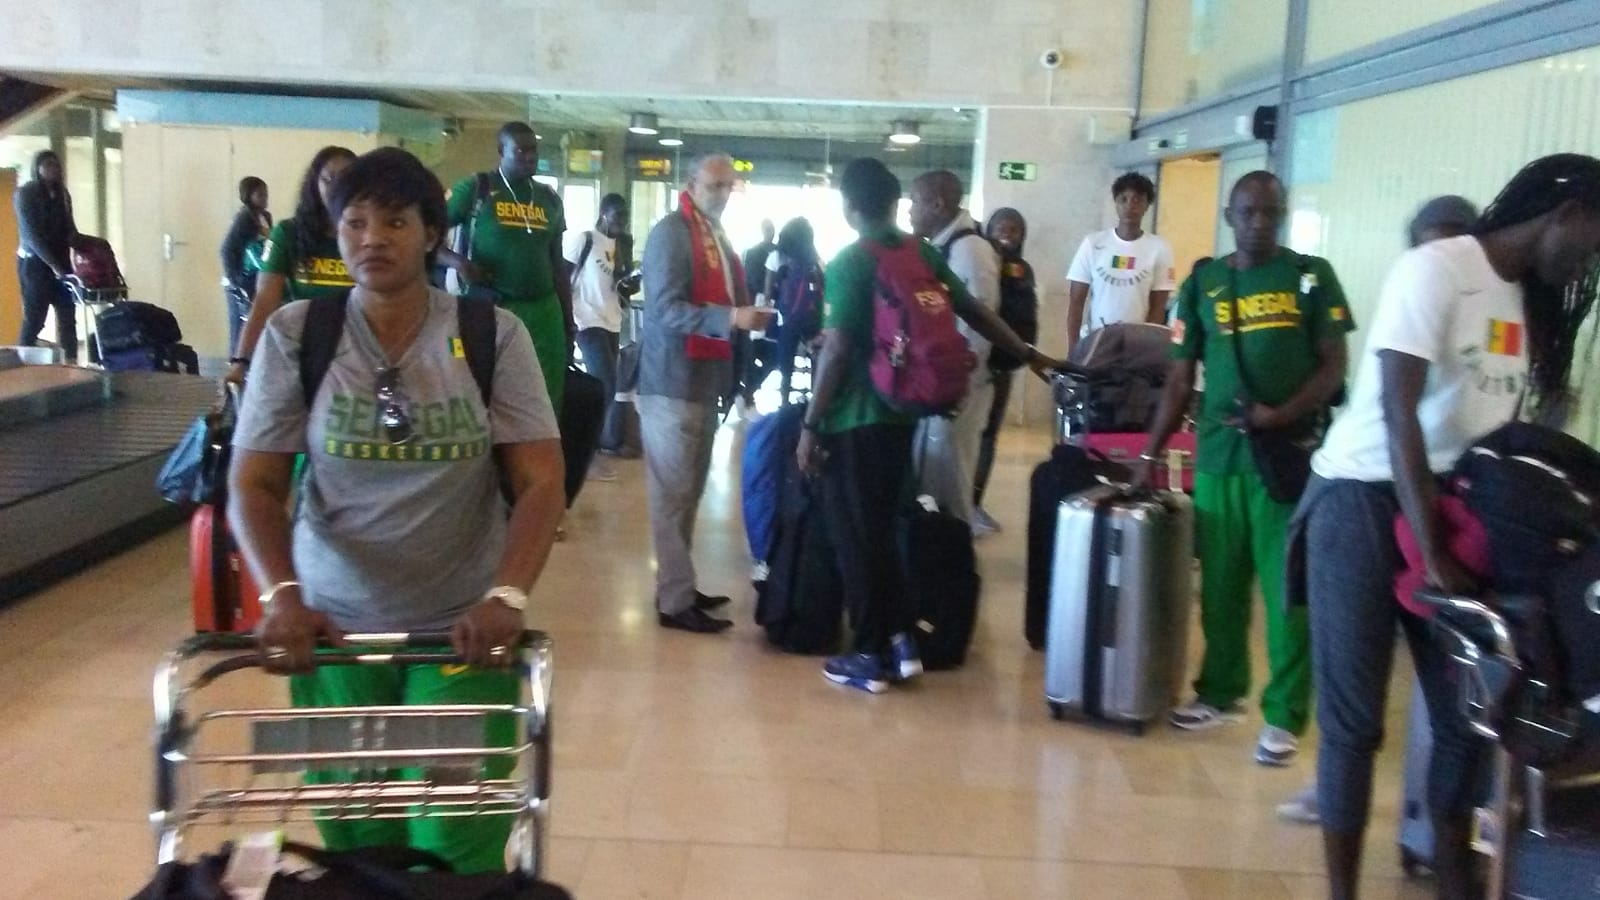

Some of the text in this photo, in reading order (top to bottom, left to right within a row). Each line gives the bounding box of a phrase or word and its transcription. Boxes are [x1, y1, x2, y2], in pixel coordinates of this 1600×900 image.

[496, 201, 549, 223] SENEGAL
[1215, 291, 1302, 324] SNEGAL
[326, 393, 488, 440] SEEGAL
